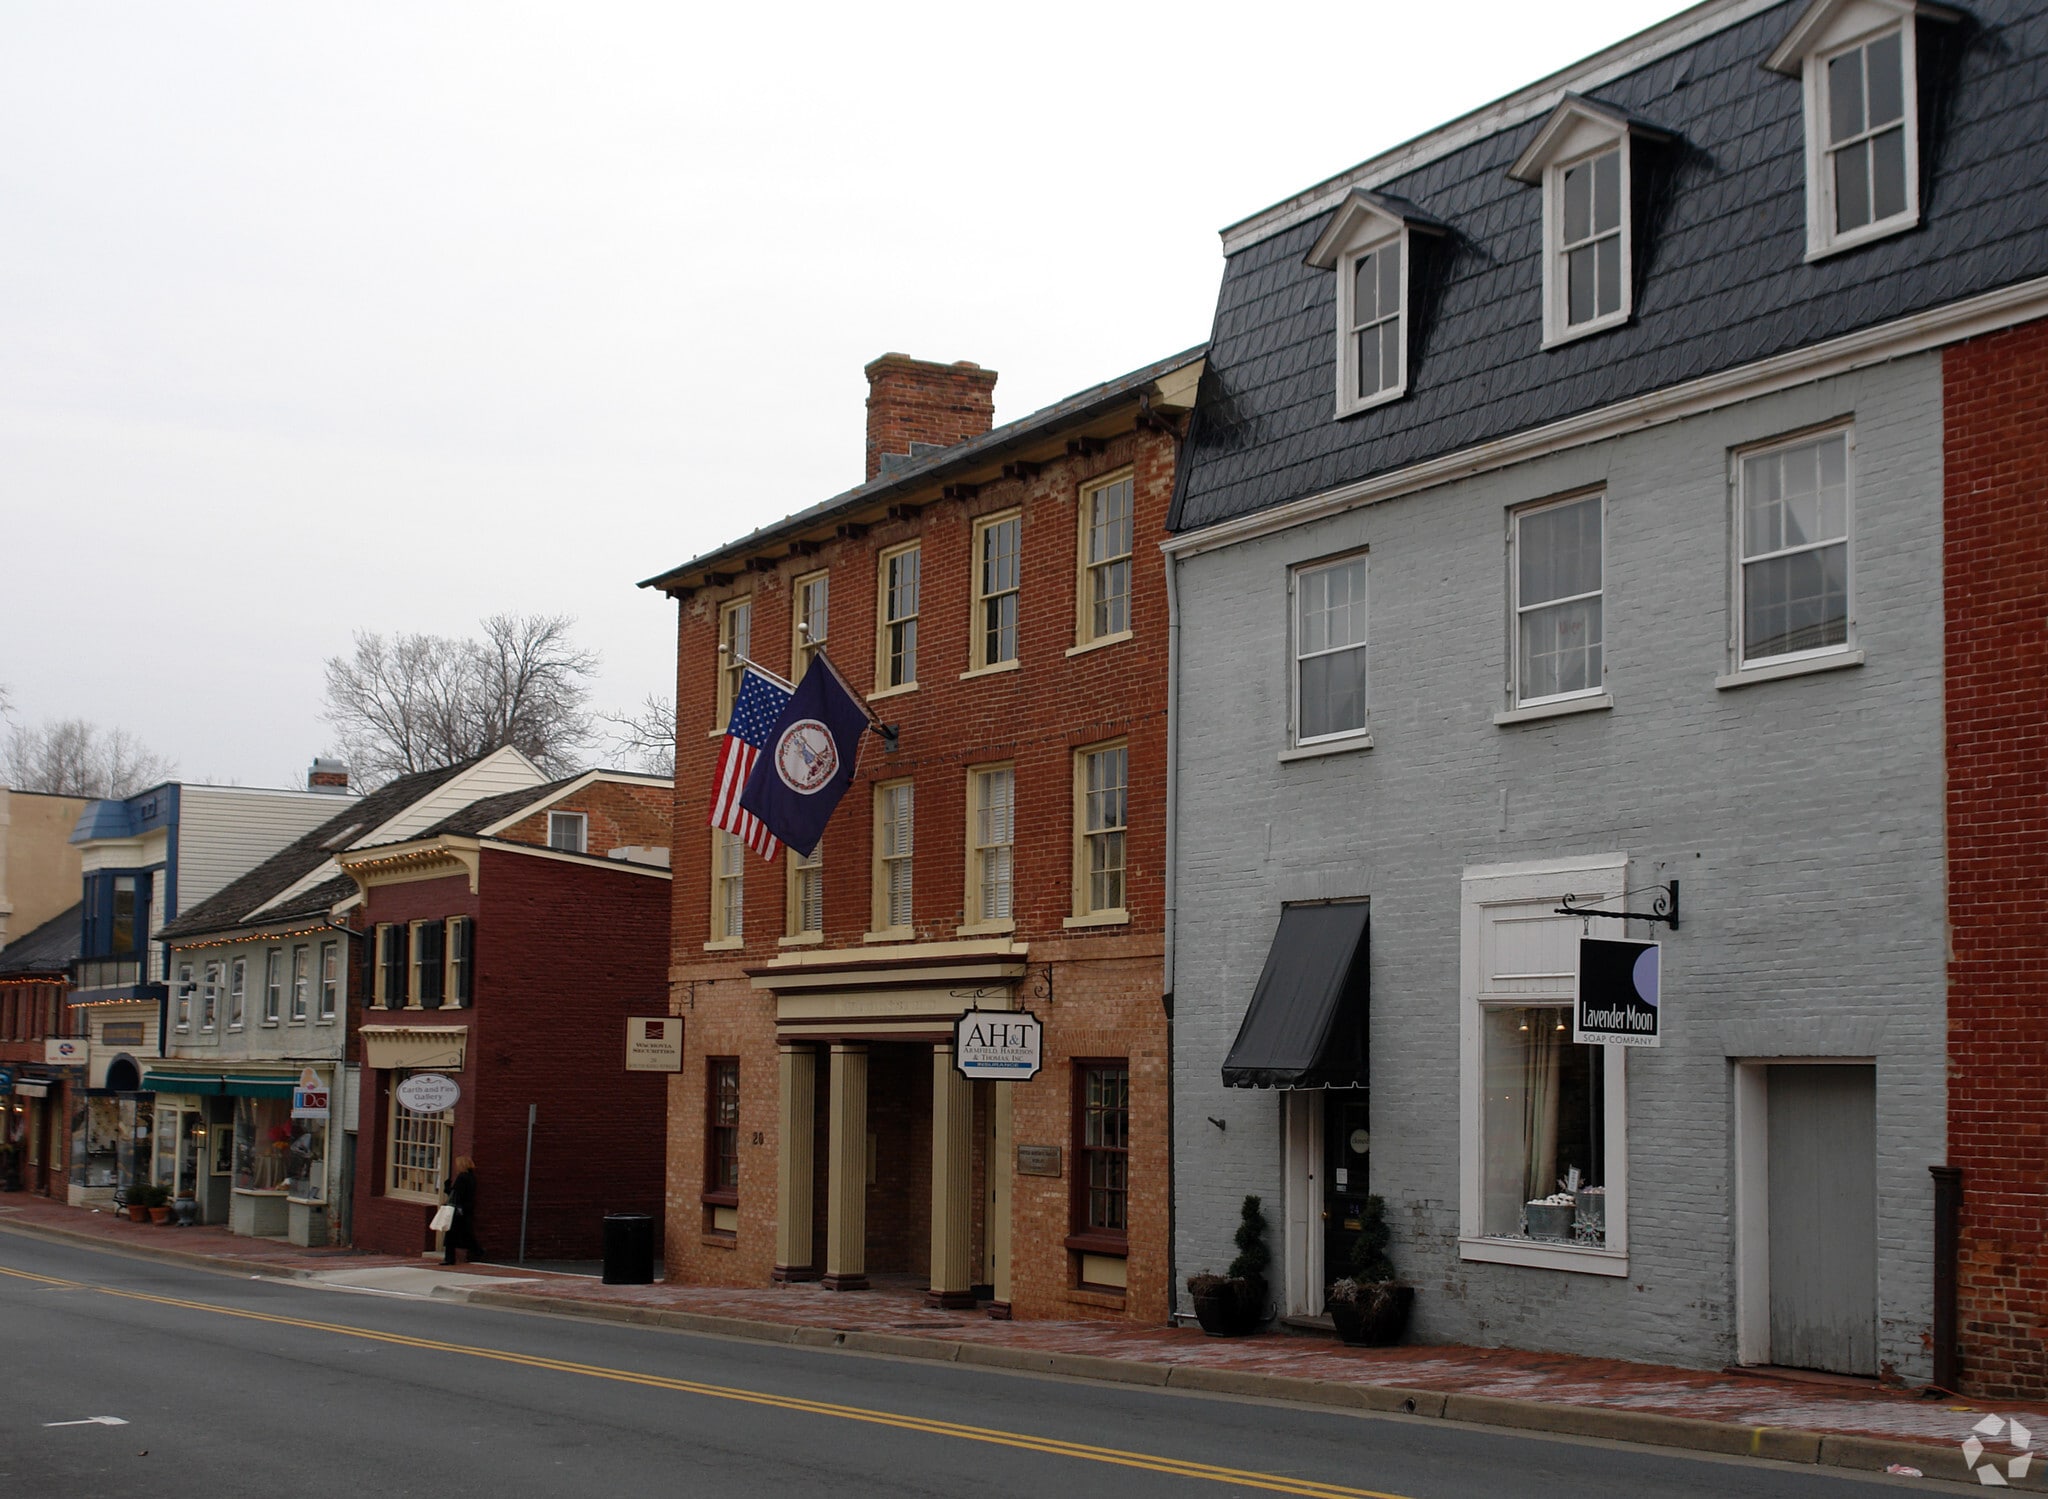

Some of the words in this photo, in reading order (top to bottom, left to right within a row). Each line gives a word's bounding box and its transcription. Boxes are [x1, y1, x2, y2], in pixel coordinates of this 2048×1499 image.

[1583, 1001, 1625, 1029] Lavender
[1626, 1004, 1653, 1031] Moon
[1583, 1034, 1606, 1043] SOAP
[1609, 1036, 1653, 1045] COMPANY
[303, 1093, 326, 1107] Do
[414, 1093, 442, 1101] Gallery
